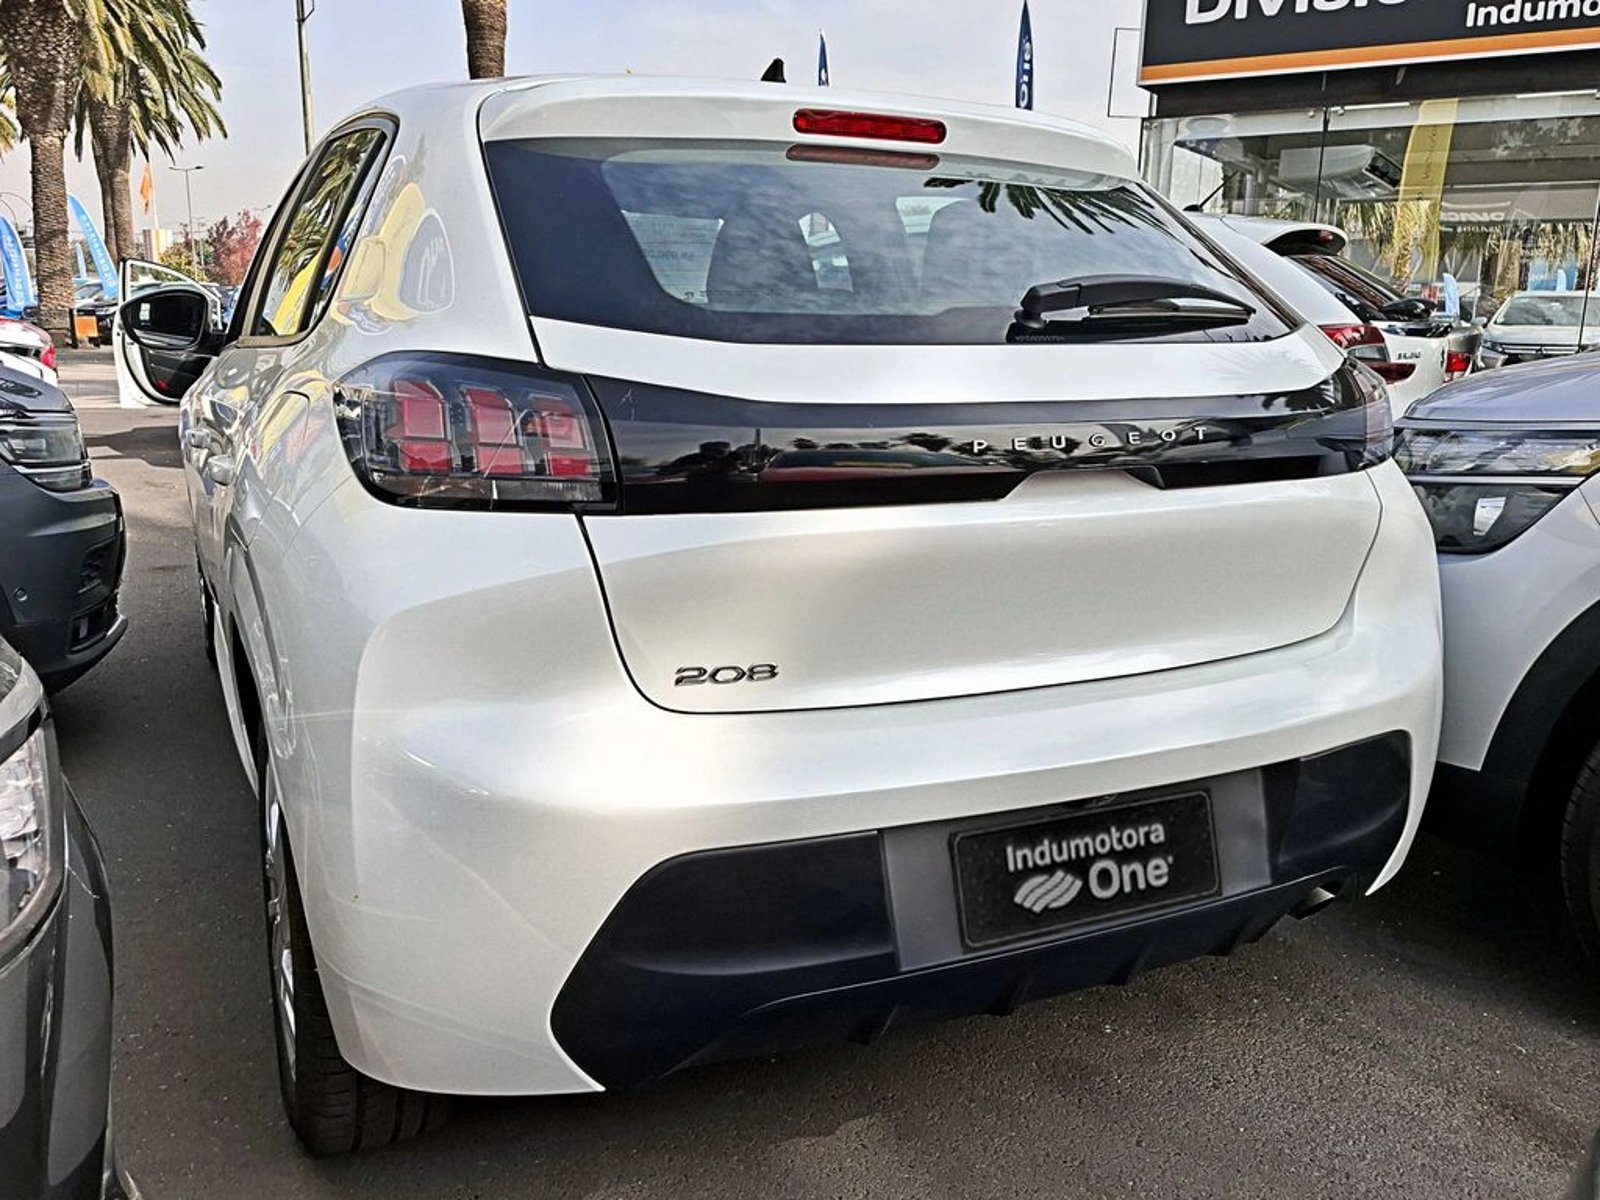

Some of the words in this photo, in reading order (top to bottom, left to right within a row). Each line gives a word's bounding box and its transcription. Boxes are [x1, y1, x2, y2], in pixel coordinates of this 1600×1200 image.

[973, 426, 1207, 453] PEUGEOT
[674, 663, 779, 687] 208
[1006, 823, 1165, 873] Indumotora
[1088, 856, 1170, 899] One
